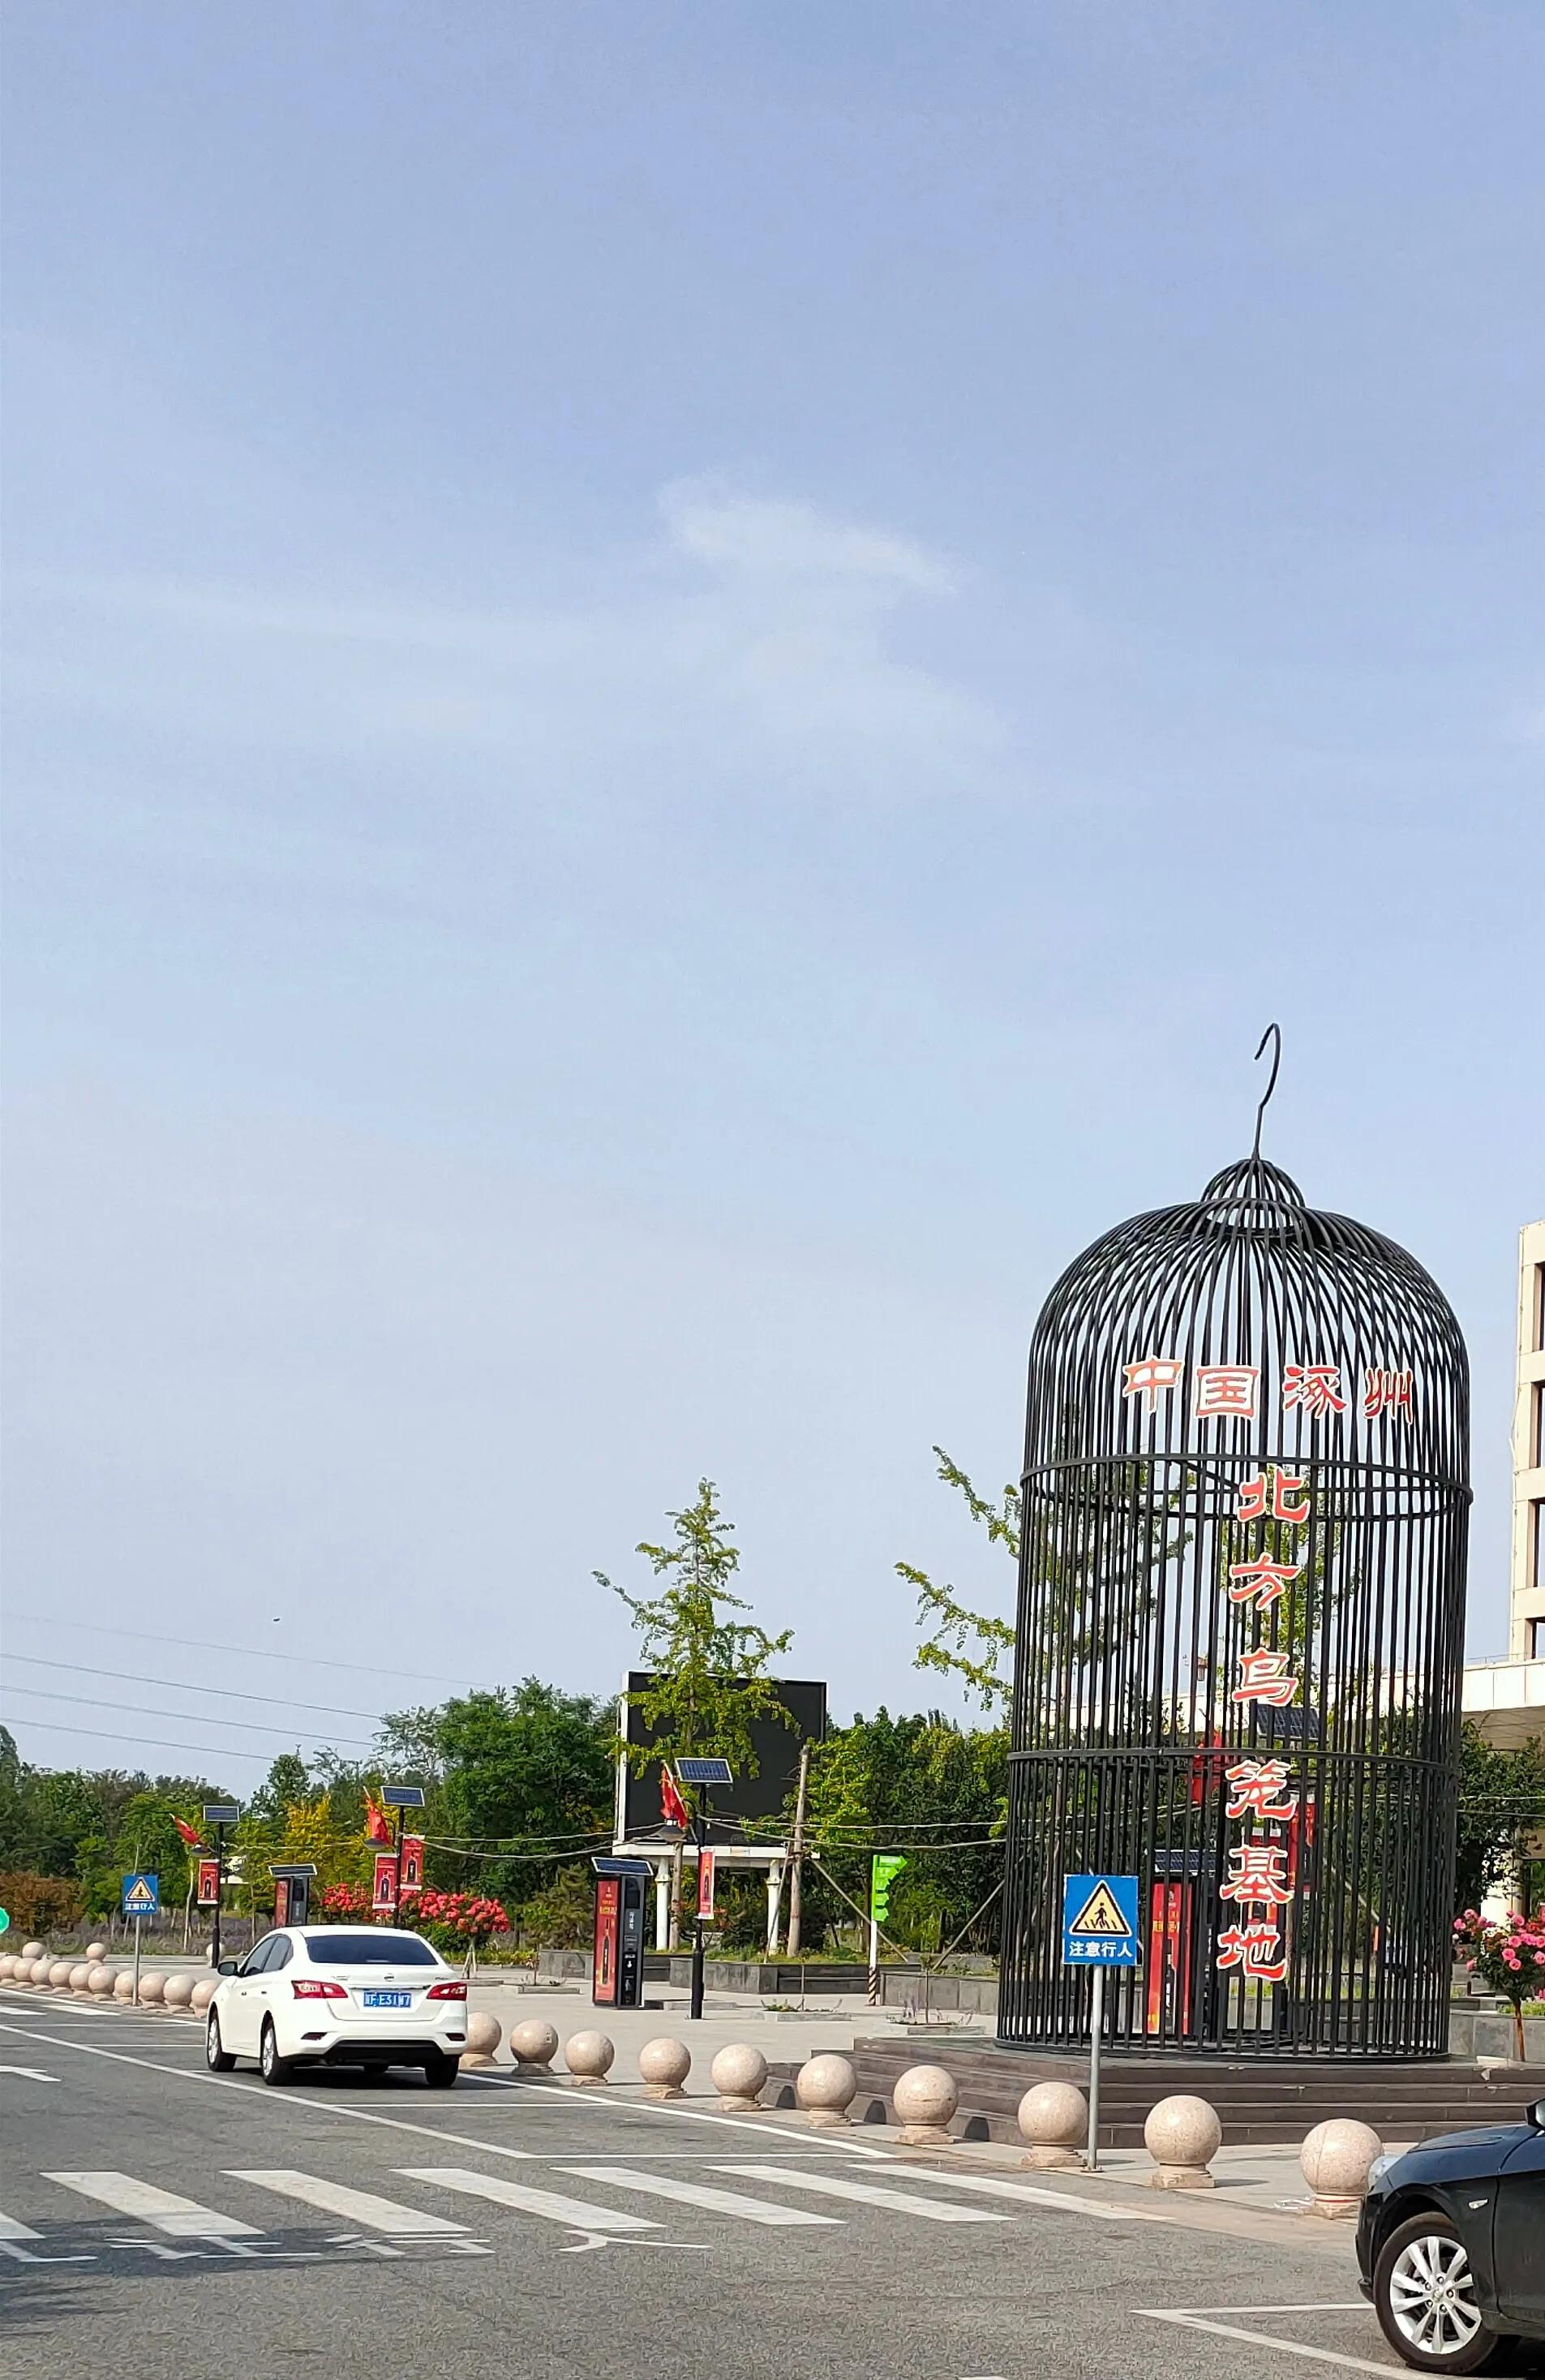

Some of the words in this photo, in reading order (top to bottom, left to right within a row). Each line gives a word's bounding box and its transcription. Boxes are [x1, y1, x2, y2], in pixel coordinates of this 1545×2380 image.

[1122, 1358, 1414, 1424] 中国涿州
[1217, 1466, 1310, 1981] 北方鸟笼基地
[1069, 1941, 1133, 1957] 注意行人
